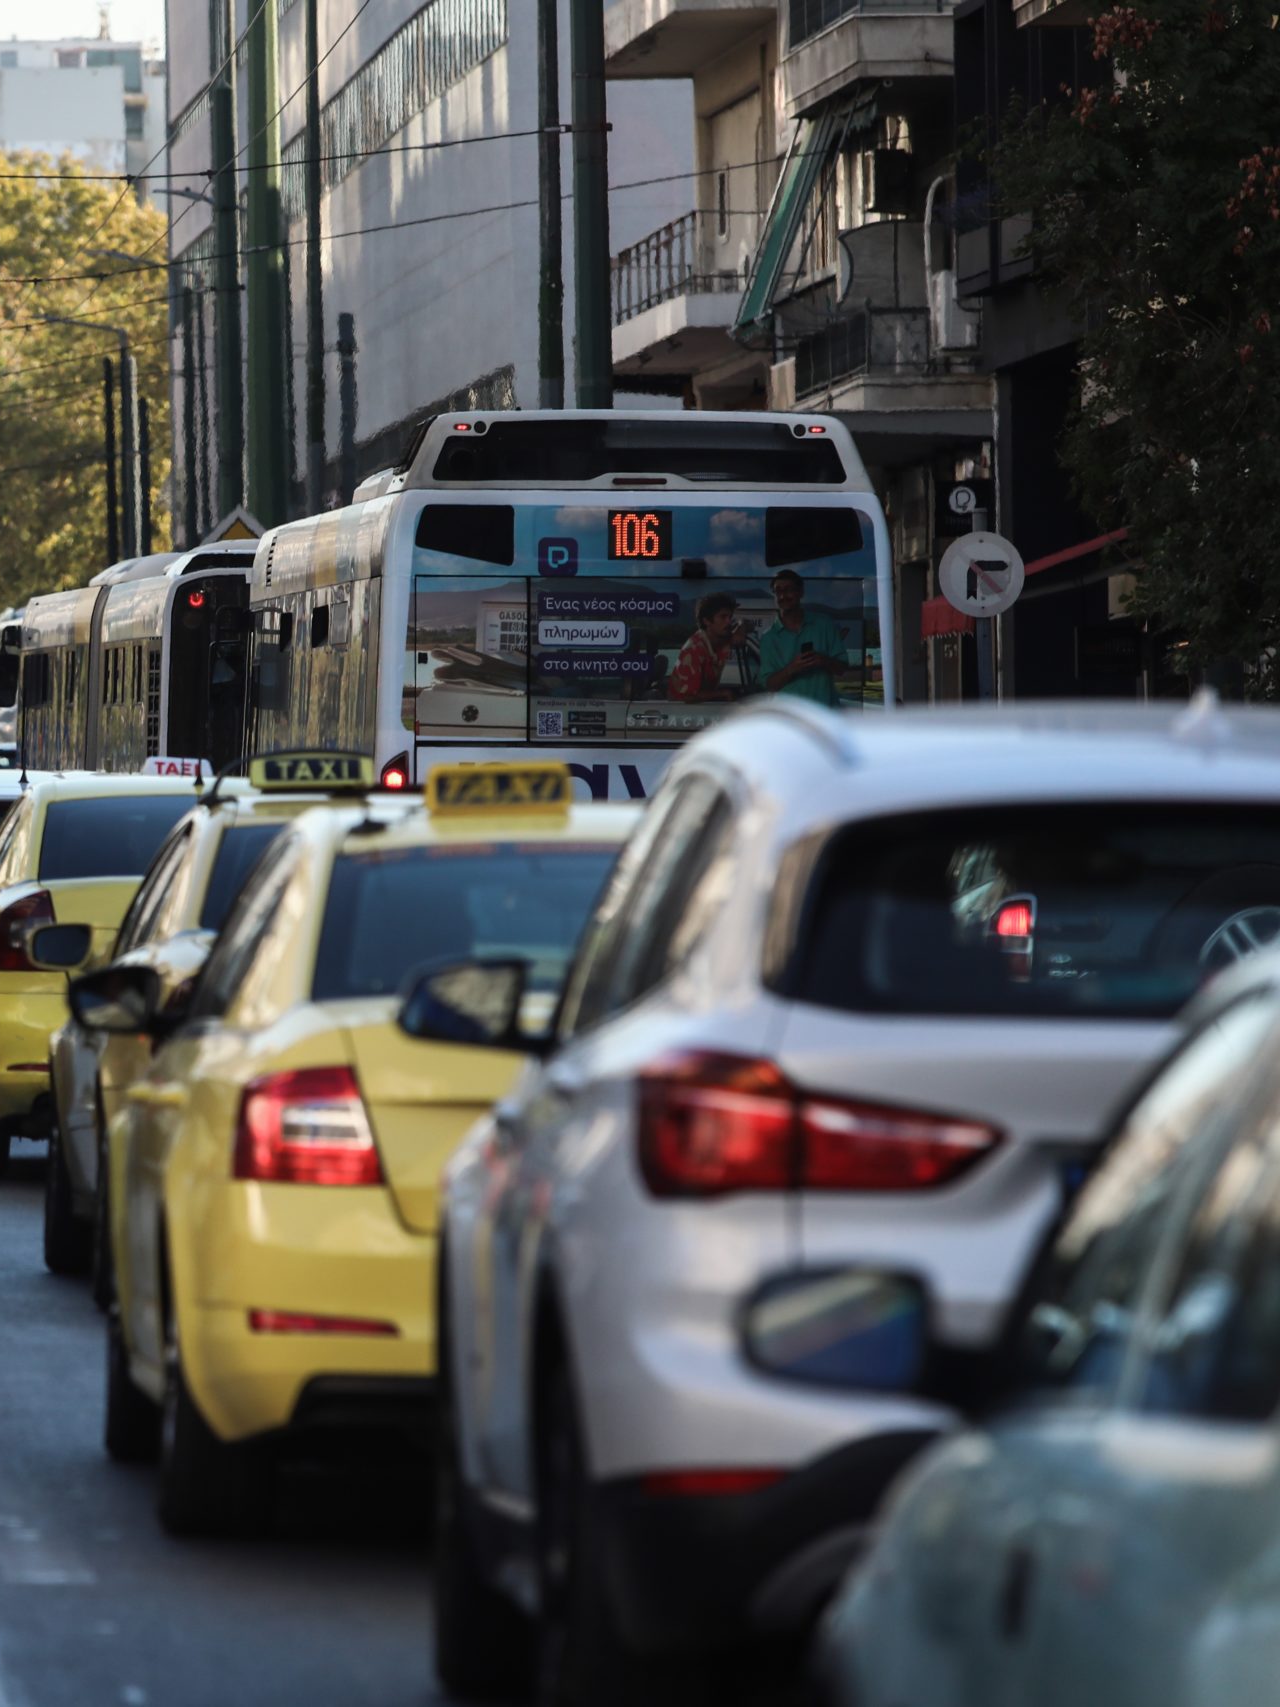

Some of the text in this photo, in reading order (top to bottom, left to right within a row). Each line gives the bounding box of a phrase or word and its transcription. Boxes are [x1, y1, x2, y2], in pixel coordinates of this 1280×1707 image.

[612, 513, 659, 556] 106
[543, 597, 673, 613] Ένας νέος κόσμος
[544, 625, 619, 641] πληρωμών
[543, 658, 649, 673] στο κινητό σου
[276, 760, 350, 780] TAXI
